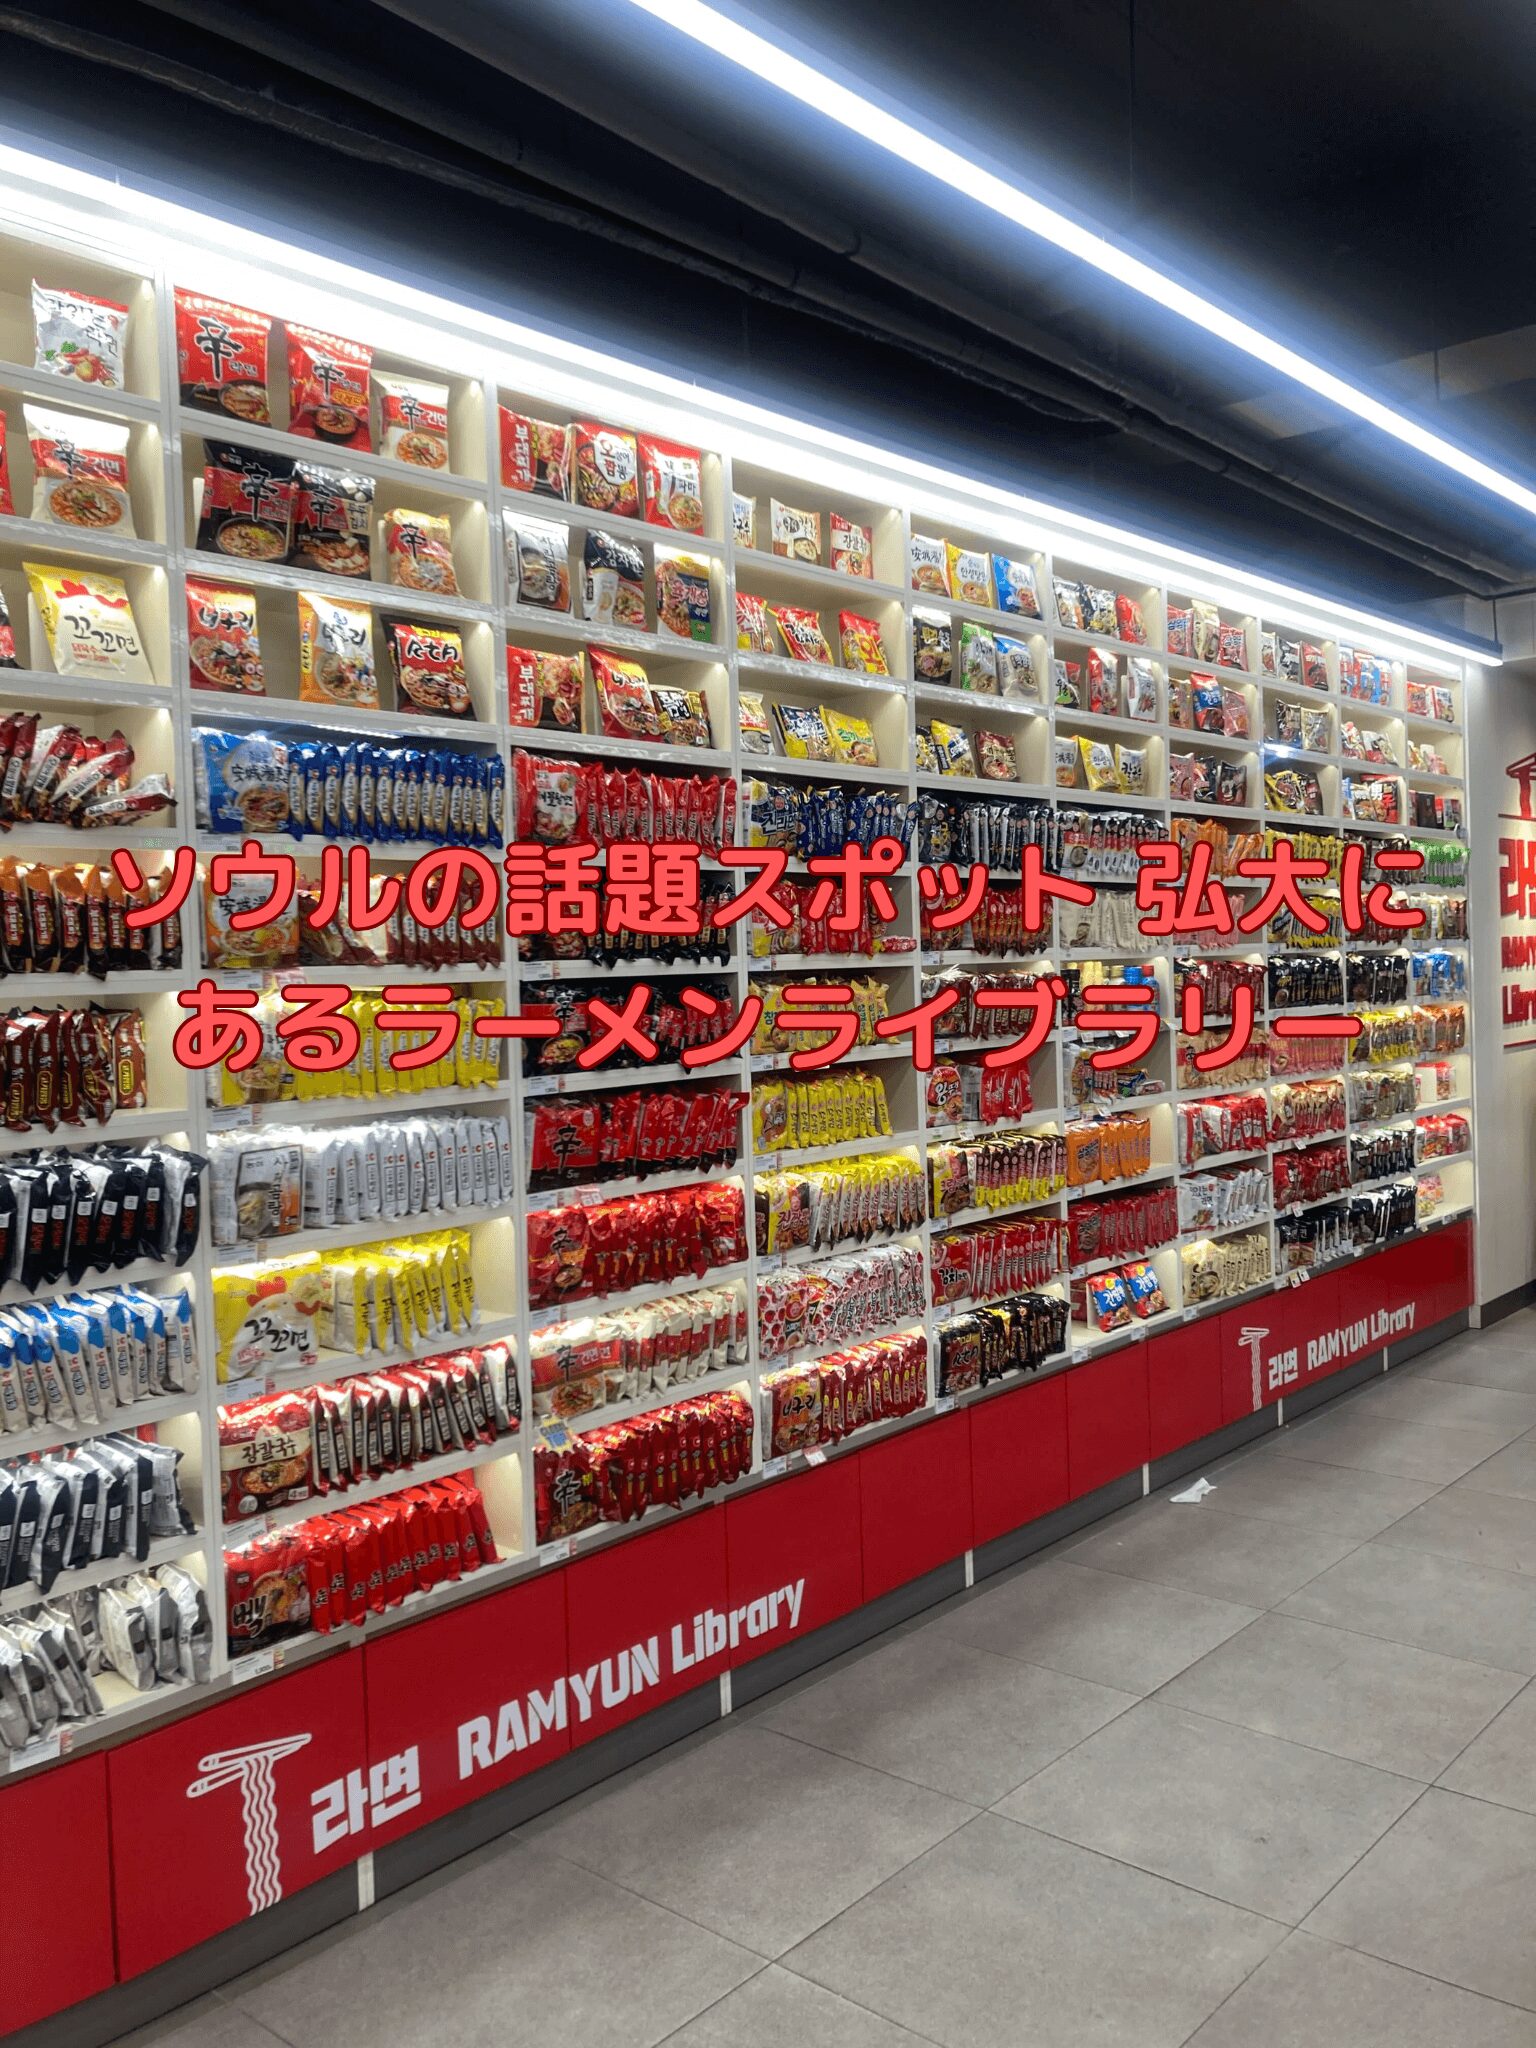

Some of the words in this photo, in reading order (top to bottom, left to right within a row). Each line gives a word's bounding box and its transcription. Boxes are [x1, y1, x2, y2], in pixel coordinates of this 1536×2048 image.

[194, 316, 244, 382] 辛
[313, 353, 345, 399] 辛
[400, 392, 424, 431] 辛
[53, 438, 87, 480] 辛
[240, 462, 280, 523] 辛
[311, 486, 338, 532] 辛
[400, 522, 427, 559] 辛
[63, 614, 140, 657] 꼬꼬면
[199, 606, 254, 634] 너구리
[553, 1124, 584, 1175] 辛
[551, 1227, 572, 1261] 辛
[243, 1315, 311, 1352] 꼬꼬면
[1268, 1347, 1299, 1390] 라면
[1307, 1318, 1368, 1371] RAMYUN
[1371, 1301, 1416, 1341] Library
[558, 1345, 579, 1382] 辛
[241, 1435, 298, 1464] 장칼국수
[554, 1472, 581, 1517] 辛
[310, 1745, 421, 1854] 라면
[457, 1636, 661, 1780] RAMYUN
[671, 1579, 806, 1675] Library
